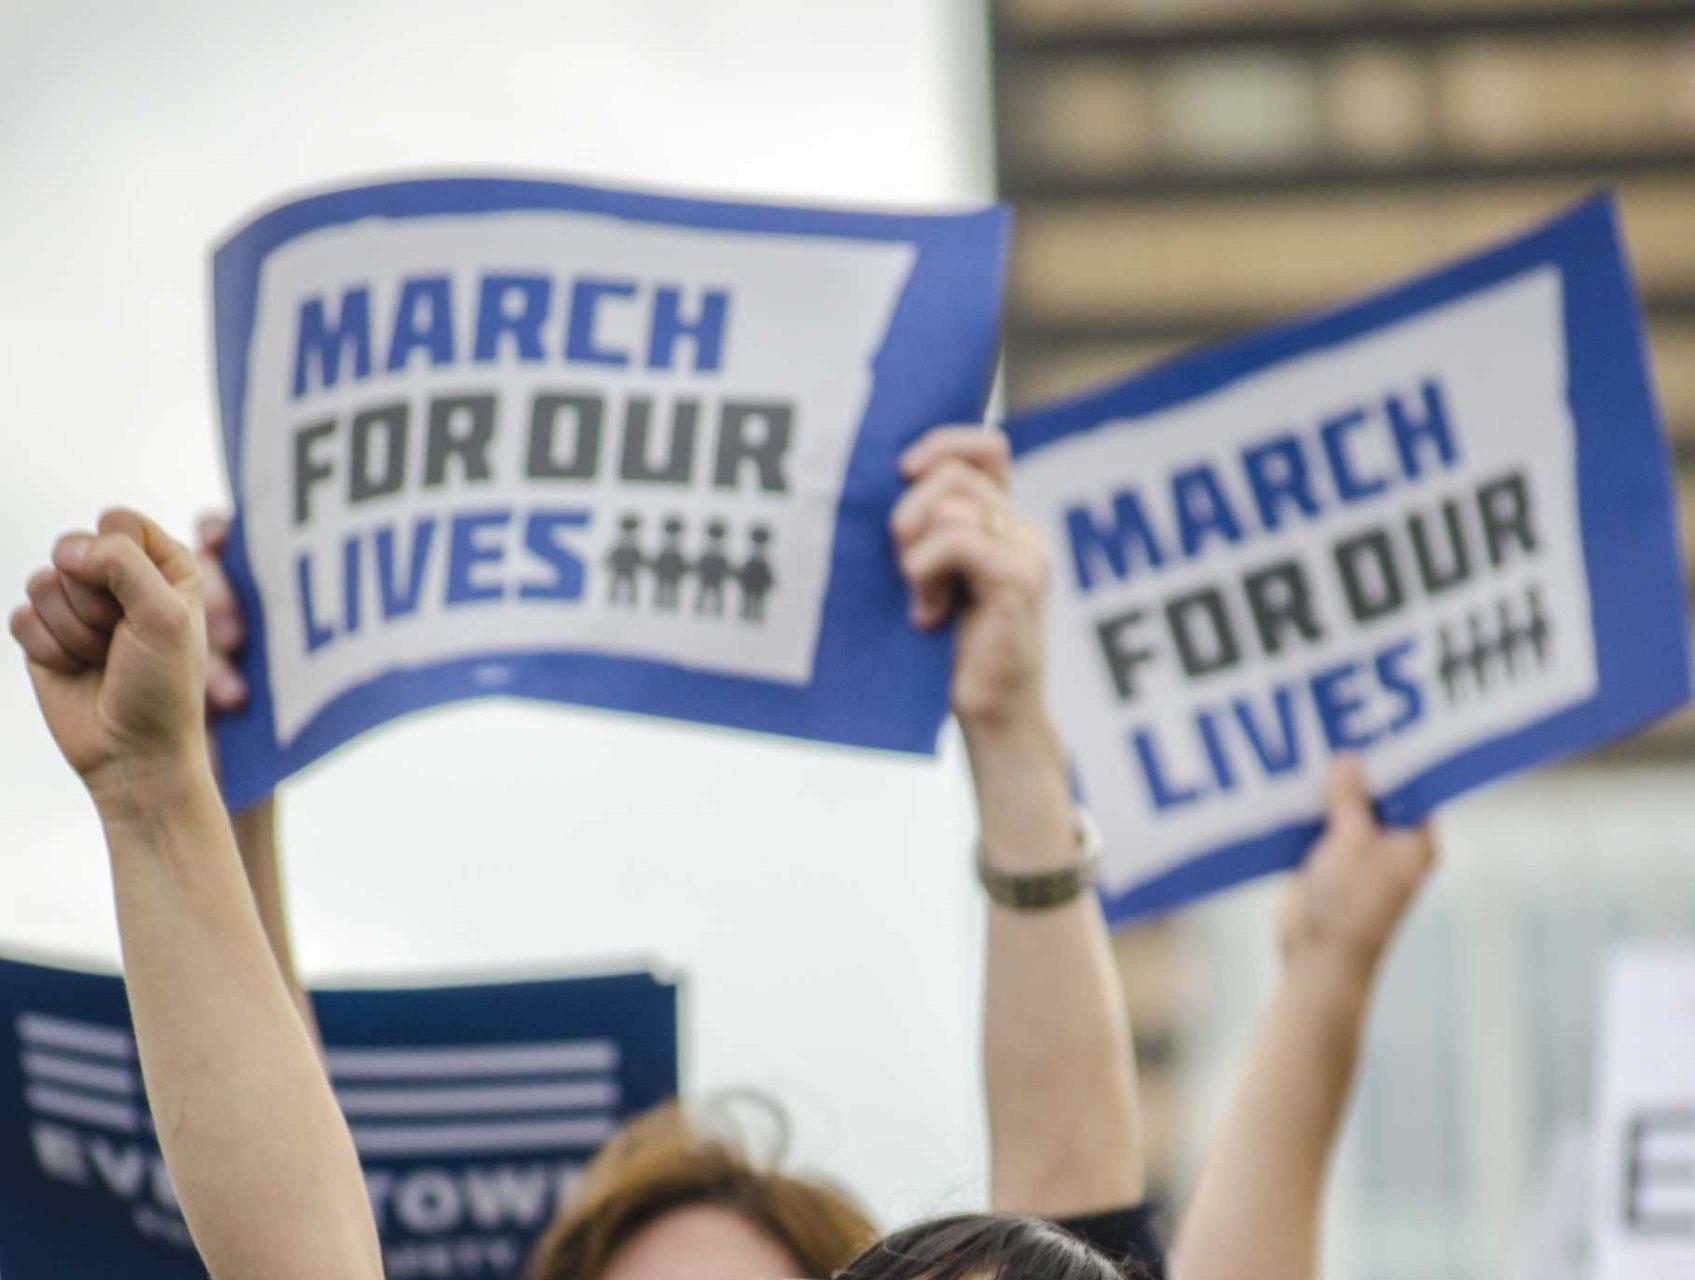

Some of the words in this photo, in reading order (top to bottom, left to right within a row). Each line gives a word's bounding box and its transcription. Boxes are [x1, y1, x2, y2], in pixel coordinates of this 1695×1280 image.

[293, 273, 731, 398] MARCH
[293, 393, 501, 527] FOR
[526, 393, 797, 493] OUR
[1063, 379, 1460, 594] MARCH
[297, 510, 594, 655] LIVES
[1096, 560, 1322, 701] FOR
[1333, 469, 1537, 624] OUR
[1130, 641, 1426, 812] LIVES
